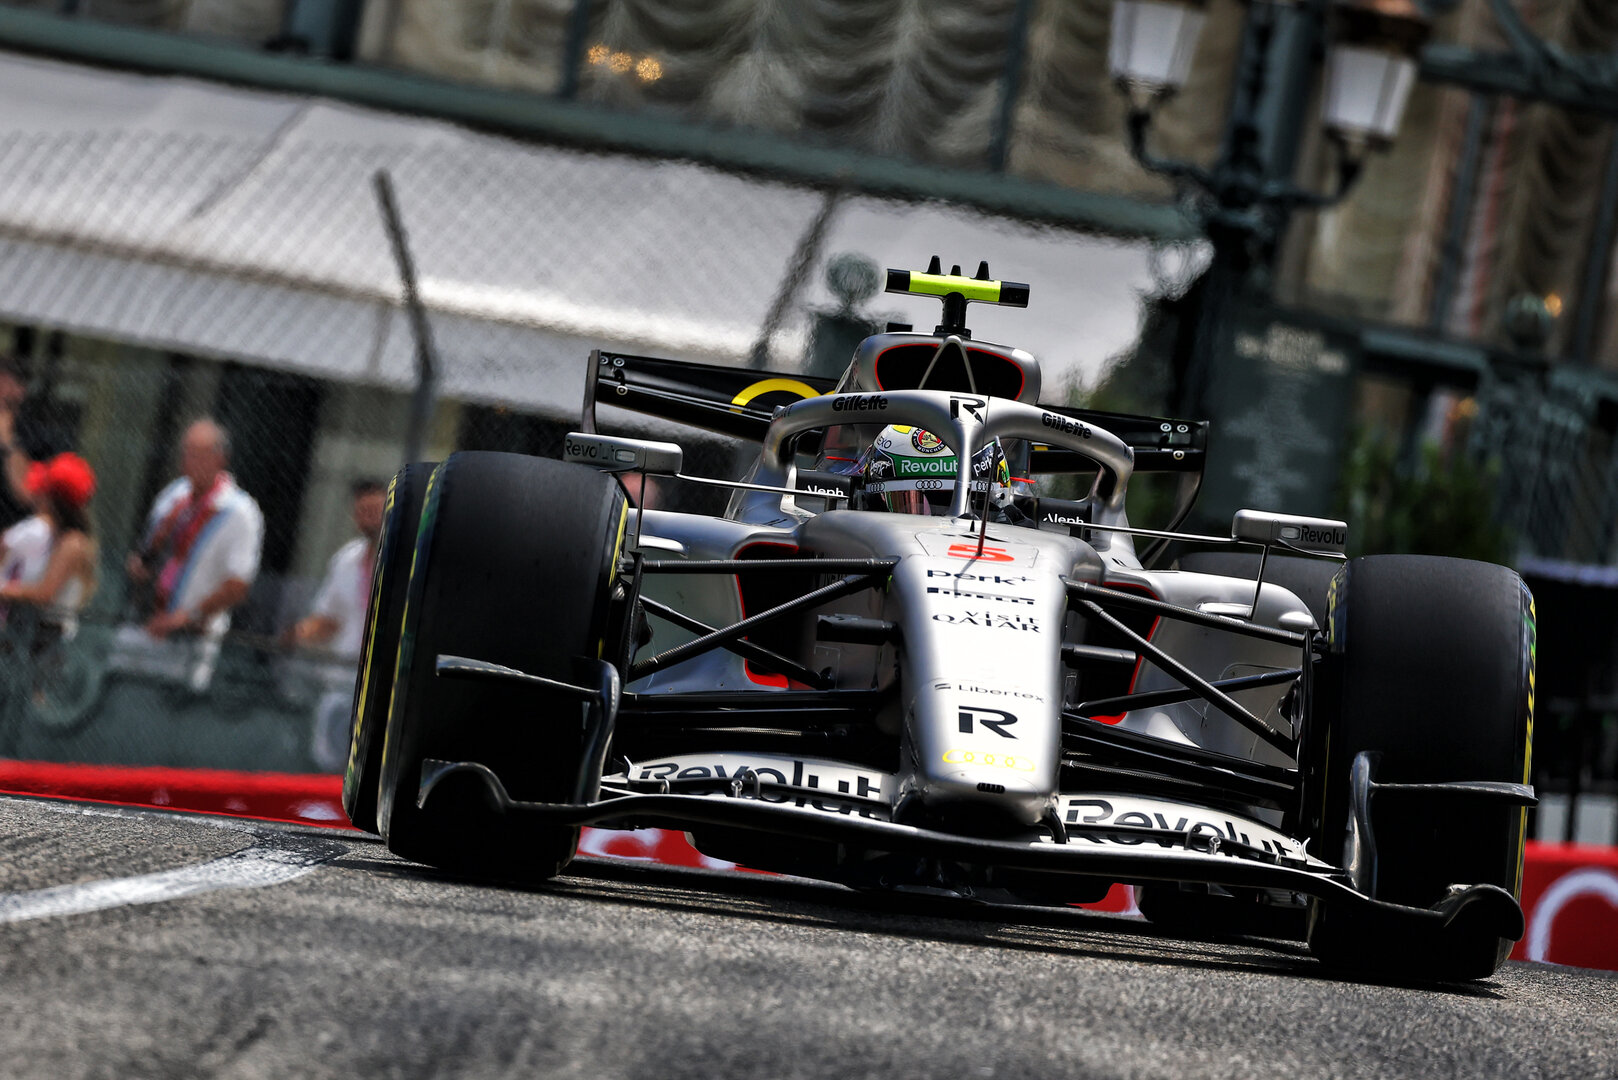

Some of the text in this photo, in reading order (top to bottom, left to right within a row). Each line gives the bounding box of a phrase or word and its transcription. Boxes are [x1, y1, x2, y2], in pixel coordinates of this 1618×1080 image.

[832, 395, 888, 411] Gillette
[949, 395, 985, 425] R
[1041, 412, 1092, 439] Gillette
[1301, 525, 1346, 545] Revolu
[947, 543, 1014, 562] 5
[932, 614, 1041, 633] QATAR
[958, 684, 1044, 703] Libertex
[958, 705, 1019, 740] R
